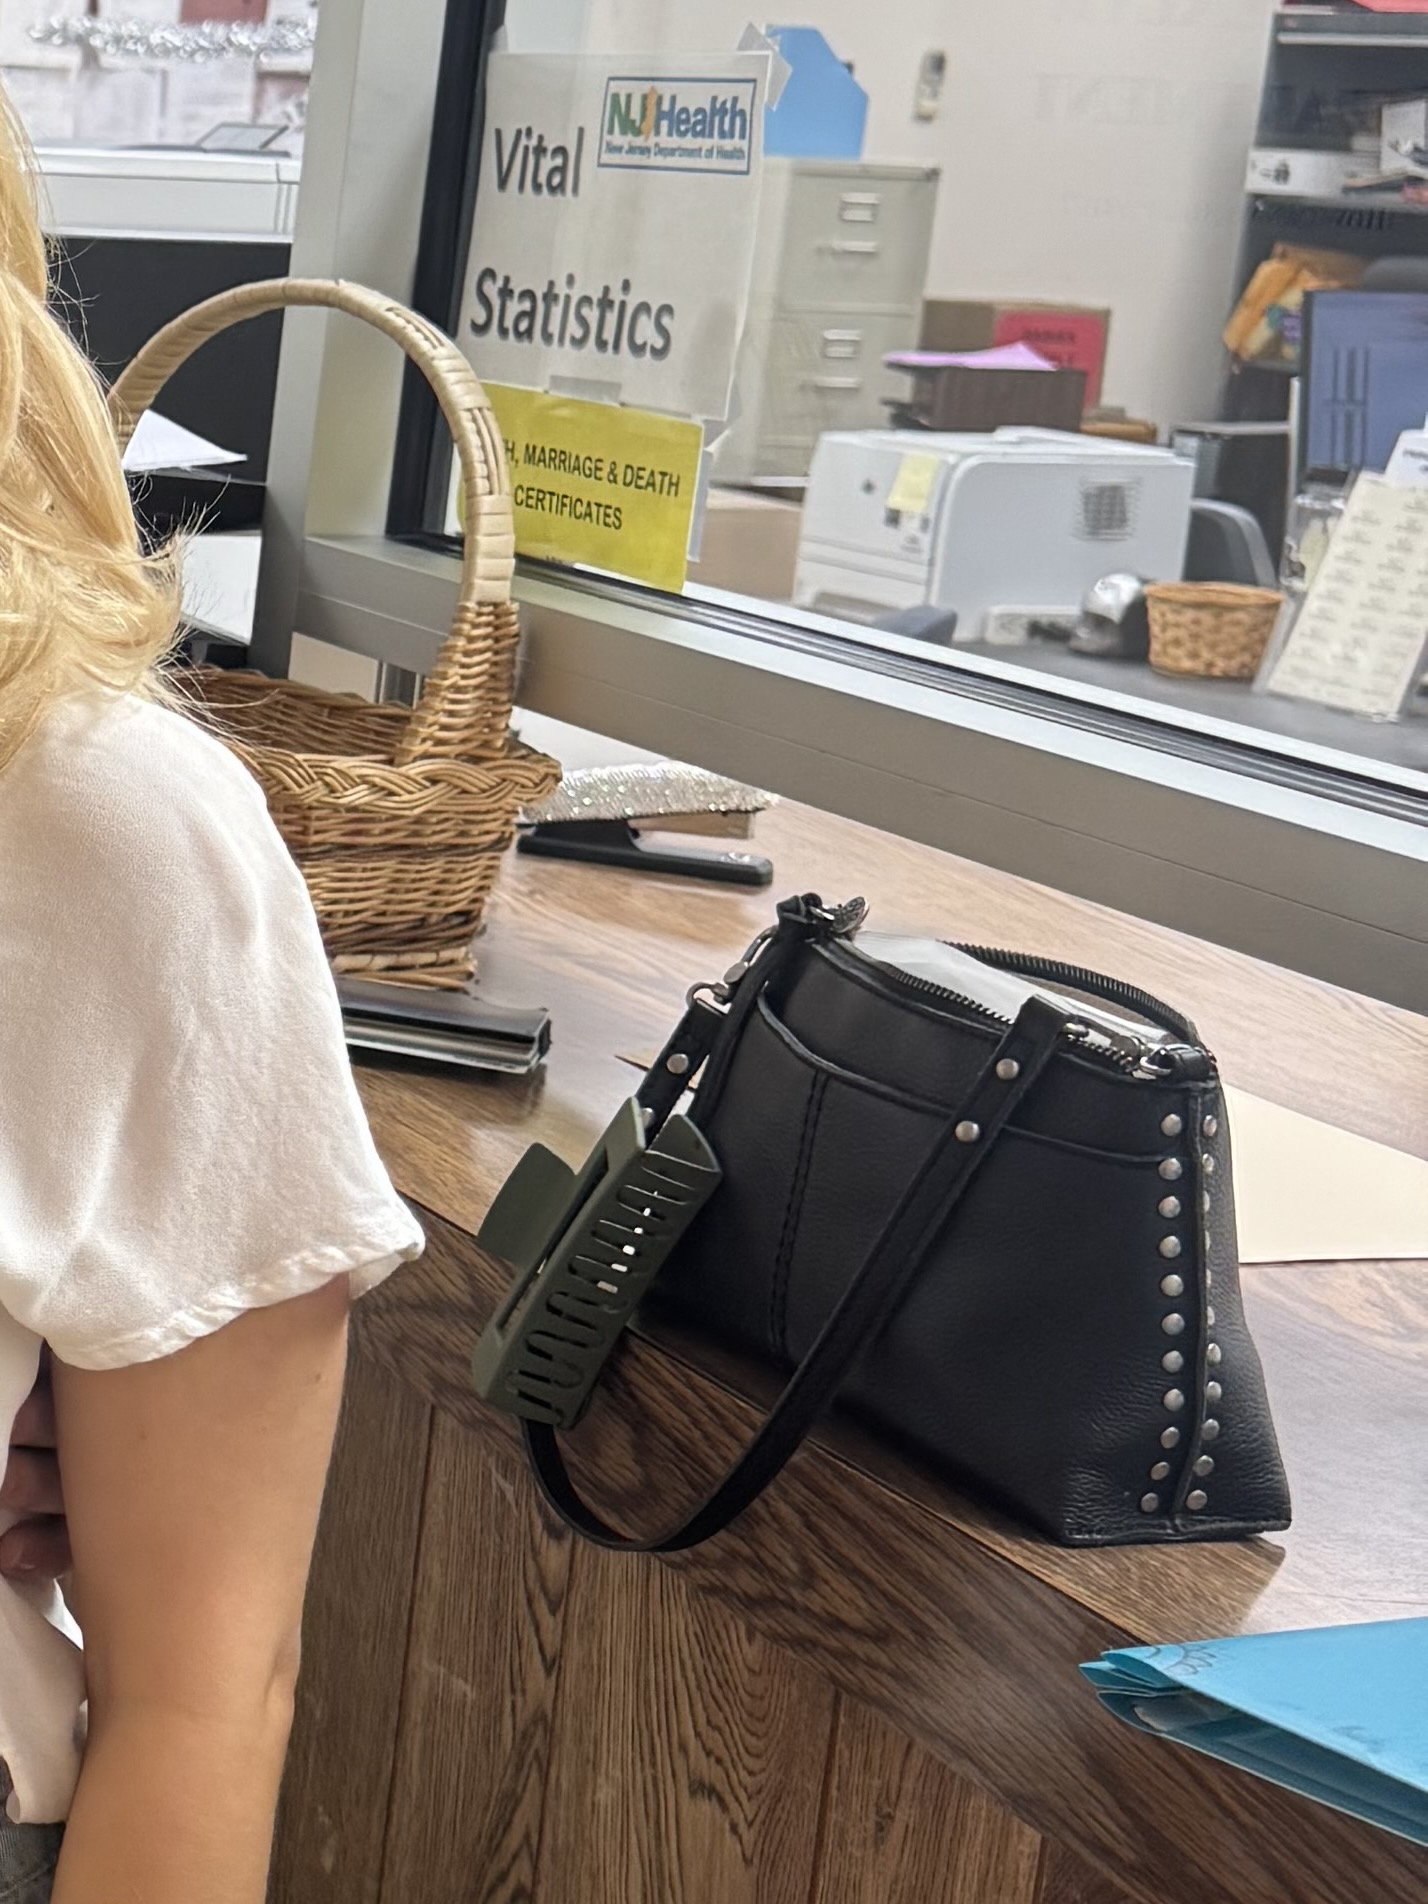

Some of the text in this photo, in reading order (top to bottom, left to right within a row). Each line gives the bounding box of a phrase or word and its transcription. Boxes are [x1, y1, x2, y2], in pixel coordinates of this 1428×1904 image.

[654, 94, 748, 140] Health
[494, 125, 585, 197] Vital
[604, 141, 624, 155] New
[654, 142, 703, 160] Department
[704, 146, 714, 159] of
[716, 146, 746, 161] Health
[470, 266, 675, 362] Statistics
[523, 443, 604, 482] MARRIAGE
[607, 460, 619, 485] &
[623, 464, 681, 498] DEATH
[514, 484, 623, 531] CERTIFICATES
